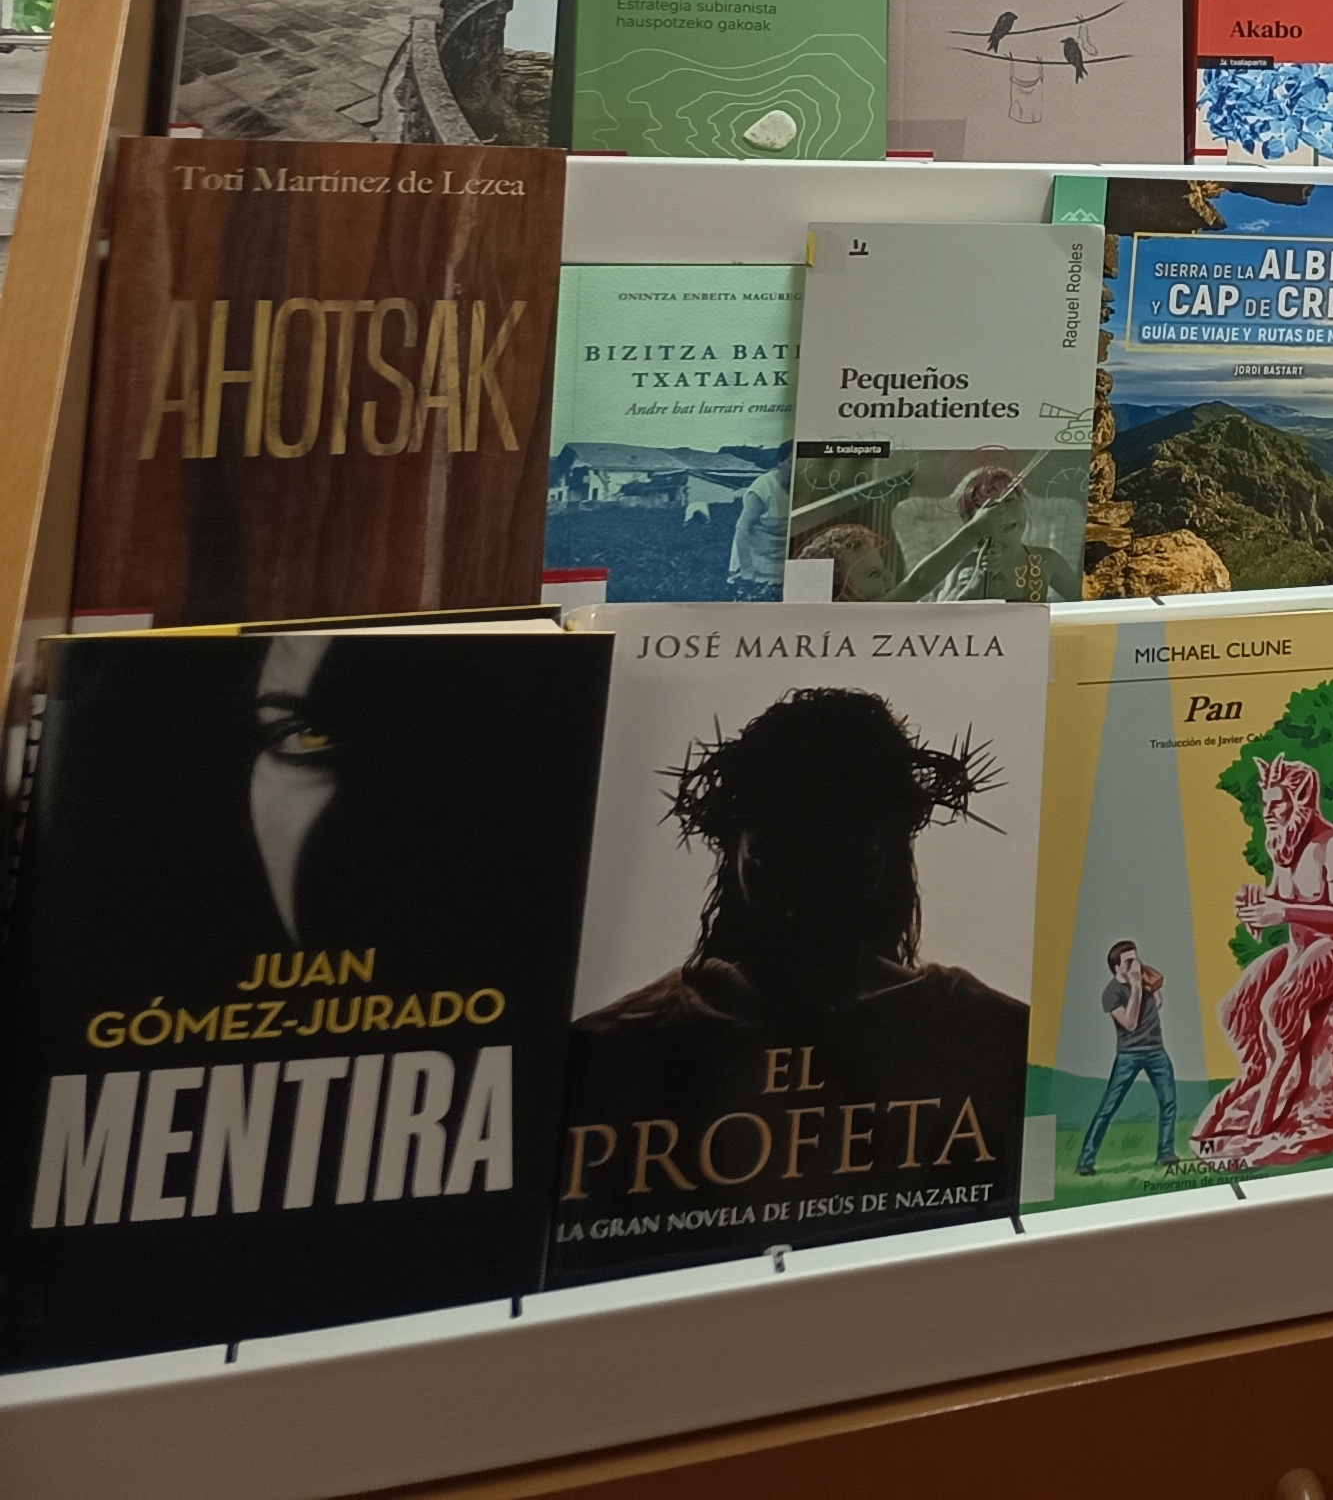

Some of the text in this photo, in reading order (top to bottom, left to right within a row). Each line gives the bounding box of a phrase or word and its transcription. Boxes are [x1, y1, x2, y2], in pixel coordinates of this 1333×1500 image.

[1229, 20, 1303, 40] Akabo
[1229, 58, 1267, 68] txalaparta
[173, 165, 526, 197] Toti Martínez de Lezea
[1155, 263, 1208, 278] SIERRA
[1213, 266, 1232, 279] DE
[1237, 266, 1253, 279] LA
[1063, 243, 1083, 349] Raquel Robles
[1152, 301, 1160, 314] Y
[1168, 284, 1239, 316] CAP
[1244, 299, 1270, 317] DE
[1142, 322, 1177, 341] GUÍA
[1180, 326, 1198, 341] DE
[1202, 327, 1240, 342] VIAJE
[1243, 327, 1252, 341] Y
[1258, 327, 1302, 342] RUTAS
[1306, 328, 1324, 342] DE
[585, 345, 718, 361] BIZITZA
[140, 297, 528, 460] AHOTSAK
[632, 370, 790, 387] TXATALAK
[840, 367, 969, 396] Pequeños
[838, 397, 1020, 420] combatientes
[637, 631, 1005, 660] JOSÉ MARÍA ZAVALA
[1134, 639, 1292, 665] MICHAEL CLUNE
[1184, 694, 1244, 724] Pan
[238, 948, 376, 992] JUAN
[87, 987, 506, 1049] GÓMEZ-JURADO
[762, 1046, 825, 1096] EL
[30, 1045, 513, 1229] MENTIRA
[559, 1096, 996, 1201] PROFETA
[1164, 1159, 1250, 1178] ANAGRAMA
